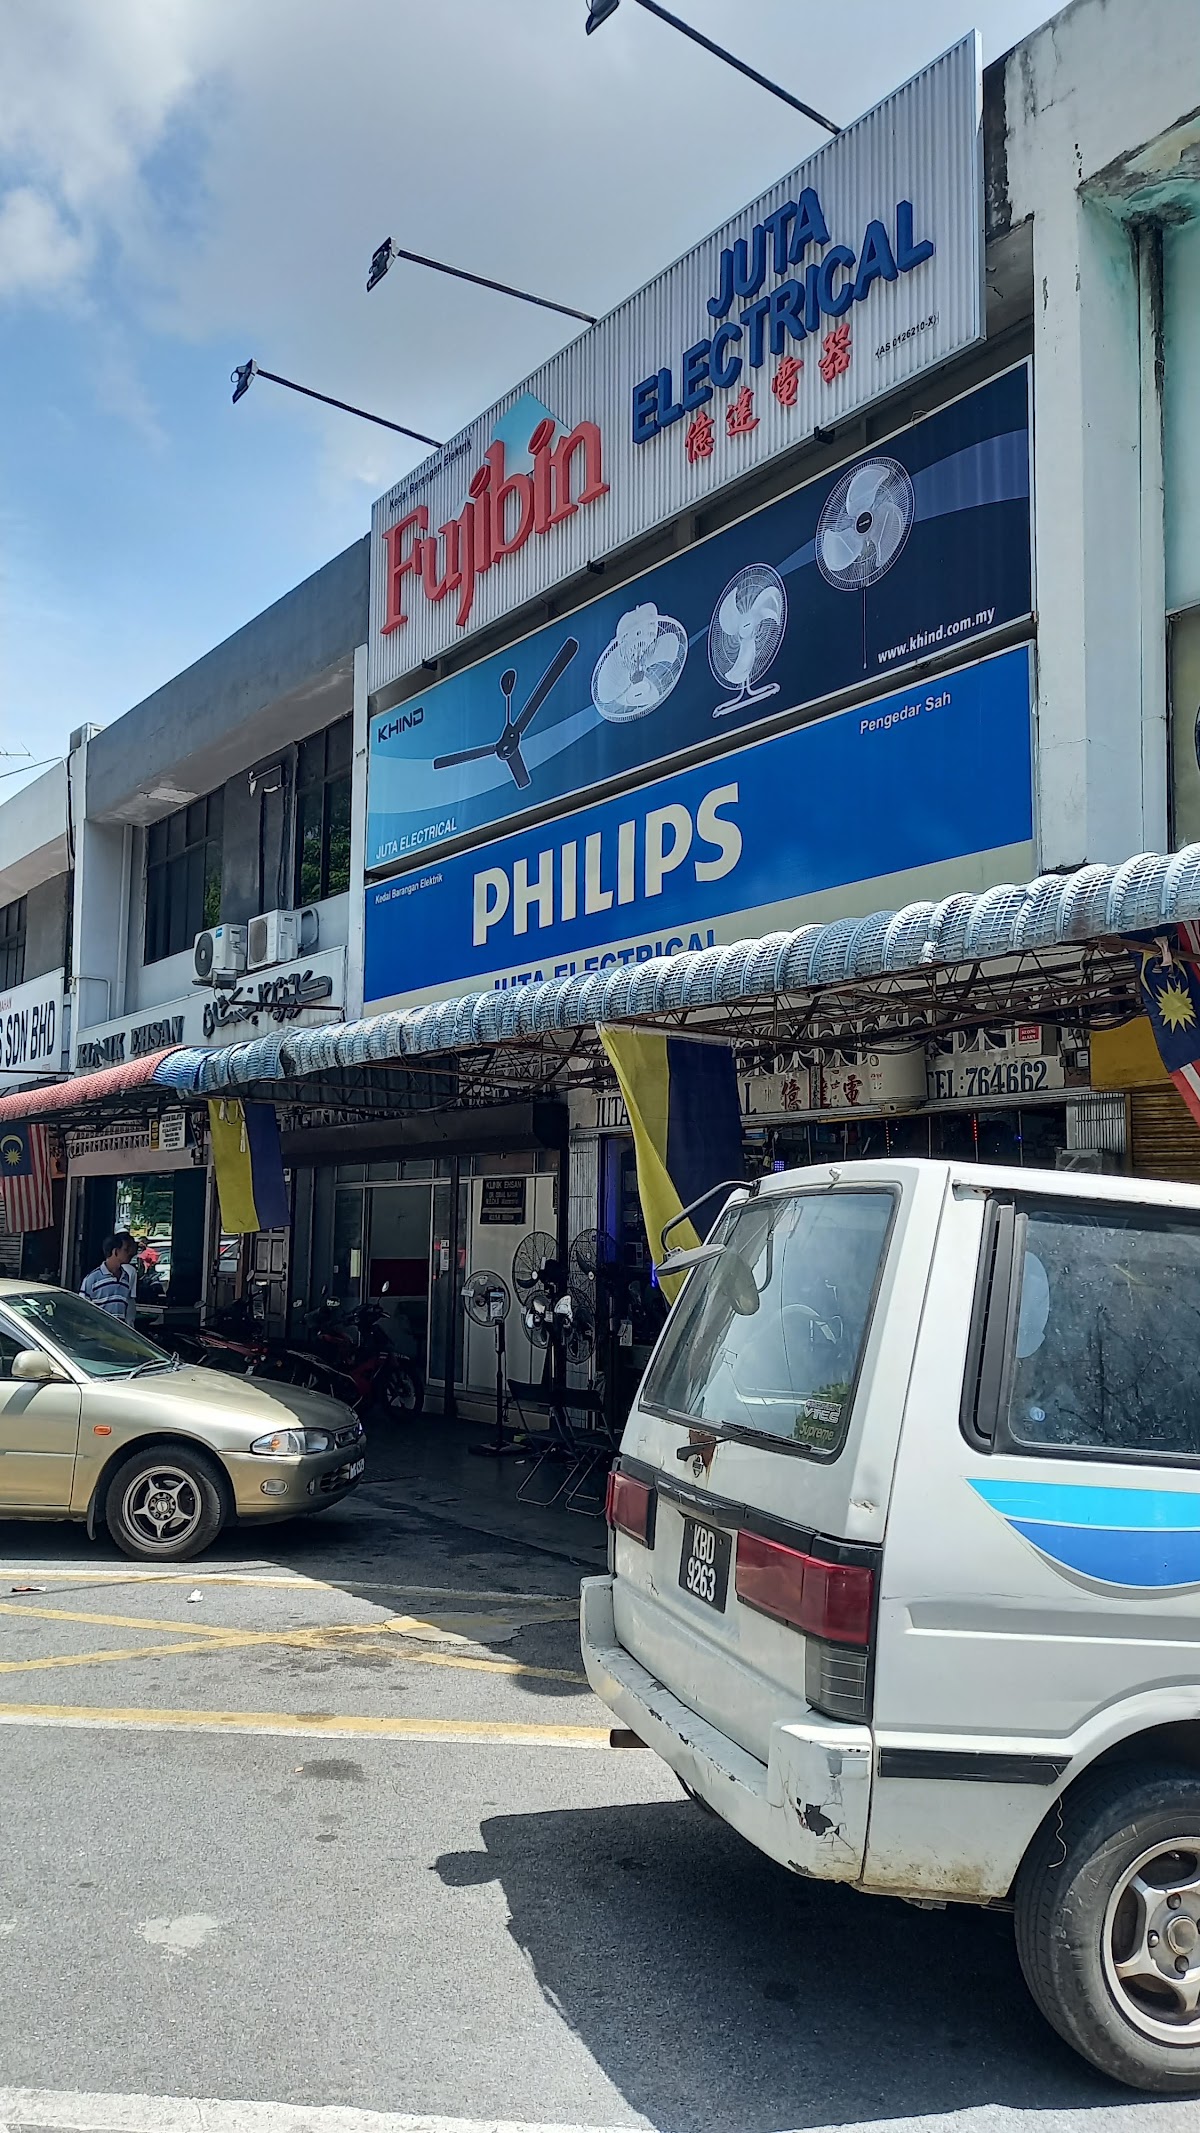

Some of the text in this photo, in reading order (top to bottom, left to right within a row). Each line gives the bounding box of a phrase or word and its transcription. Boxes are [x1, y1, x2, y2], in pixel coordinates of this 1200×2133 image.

[708, 187, 830, 318] JUTA
[633, 201, 934, 445] ELECTRICAL
[685, 323, 851, 464] 億達電器
[389, 438, 472, 512] Kedai Barangan Elektrik
[380, 417, 610, 635] Fujibin
[877, 607, 996, 664] www.khind.com.my
[377, 706, 425, 744] KHIND
[859, 691, 951, 735] Pengedar Sah
[376, 816, 458, 860] JUTA ELECTRICAL
[375, 872, 443, 905] Kedai Barangan Elektrik
[472, 782, 743, 947] PHILIPS
[6, 1009, 29, 1068] SDN
[30, 1000, 55, 1060] BHD
[130, 1016, 185, 1055] EHSAN
[800, 1420, 835, 1441] Supreme
[692, 1523, 716, 1565] KBD
[686, 1556, 717, 1602] 9263
